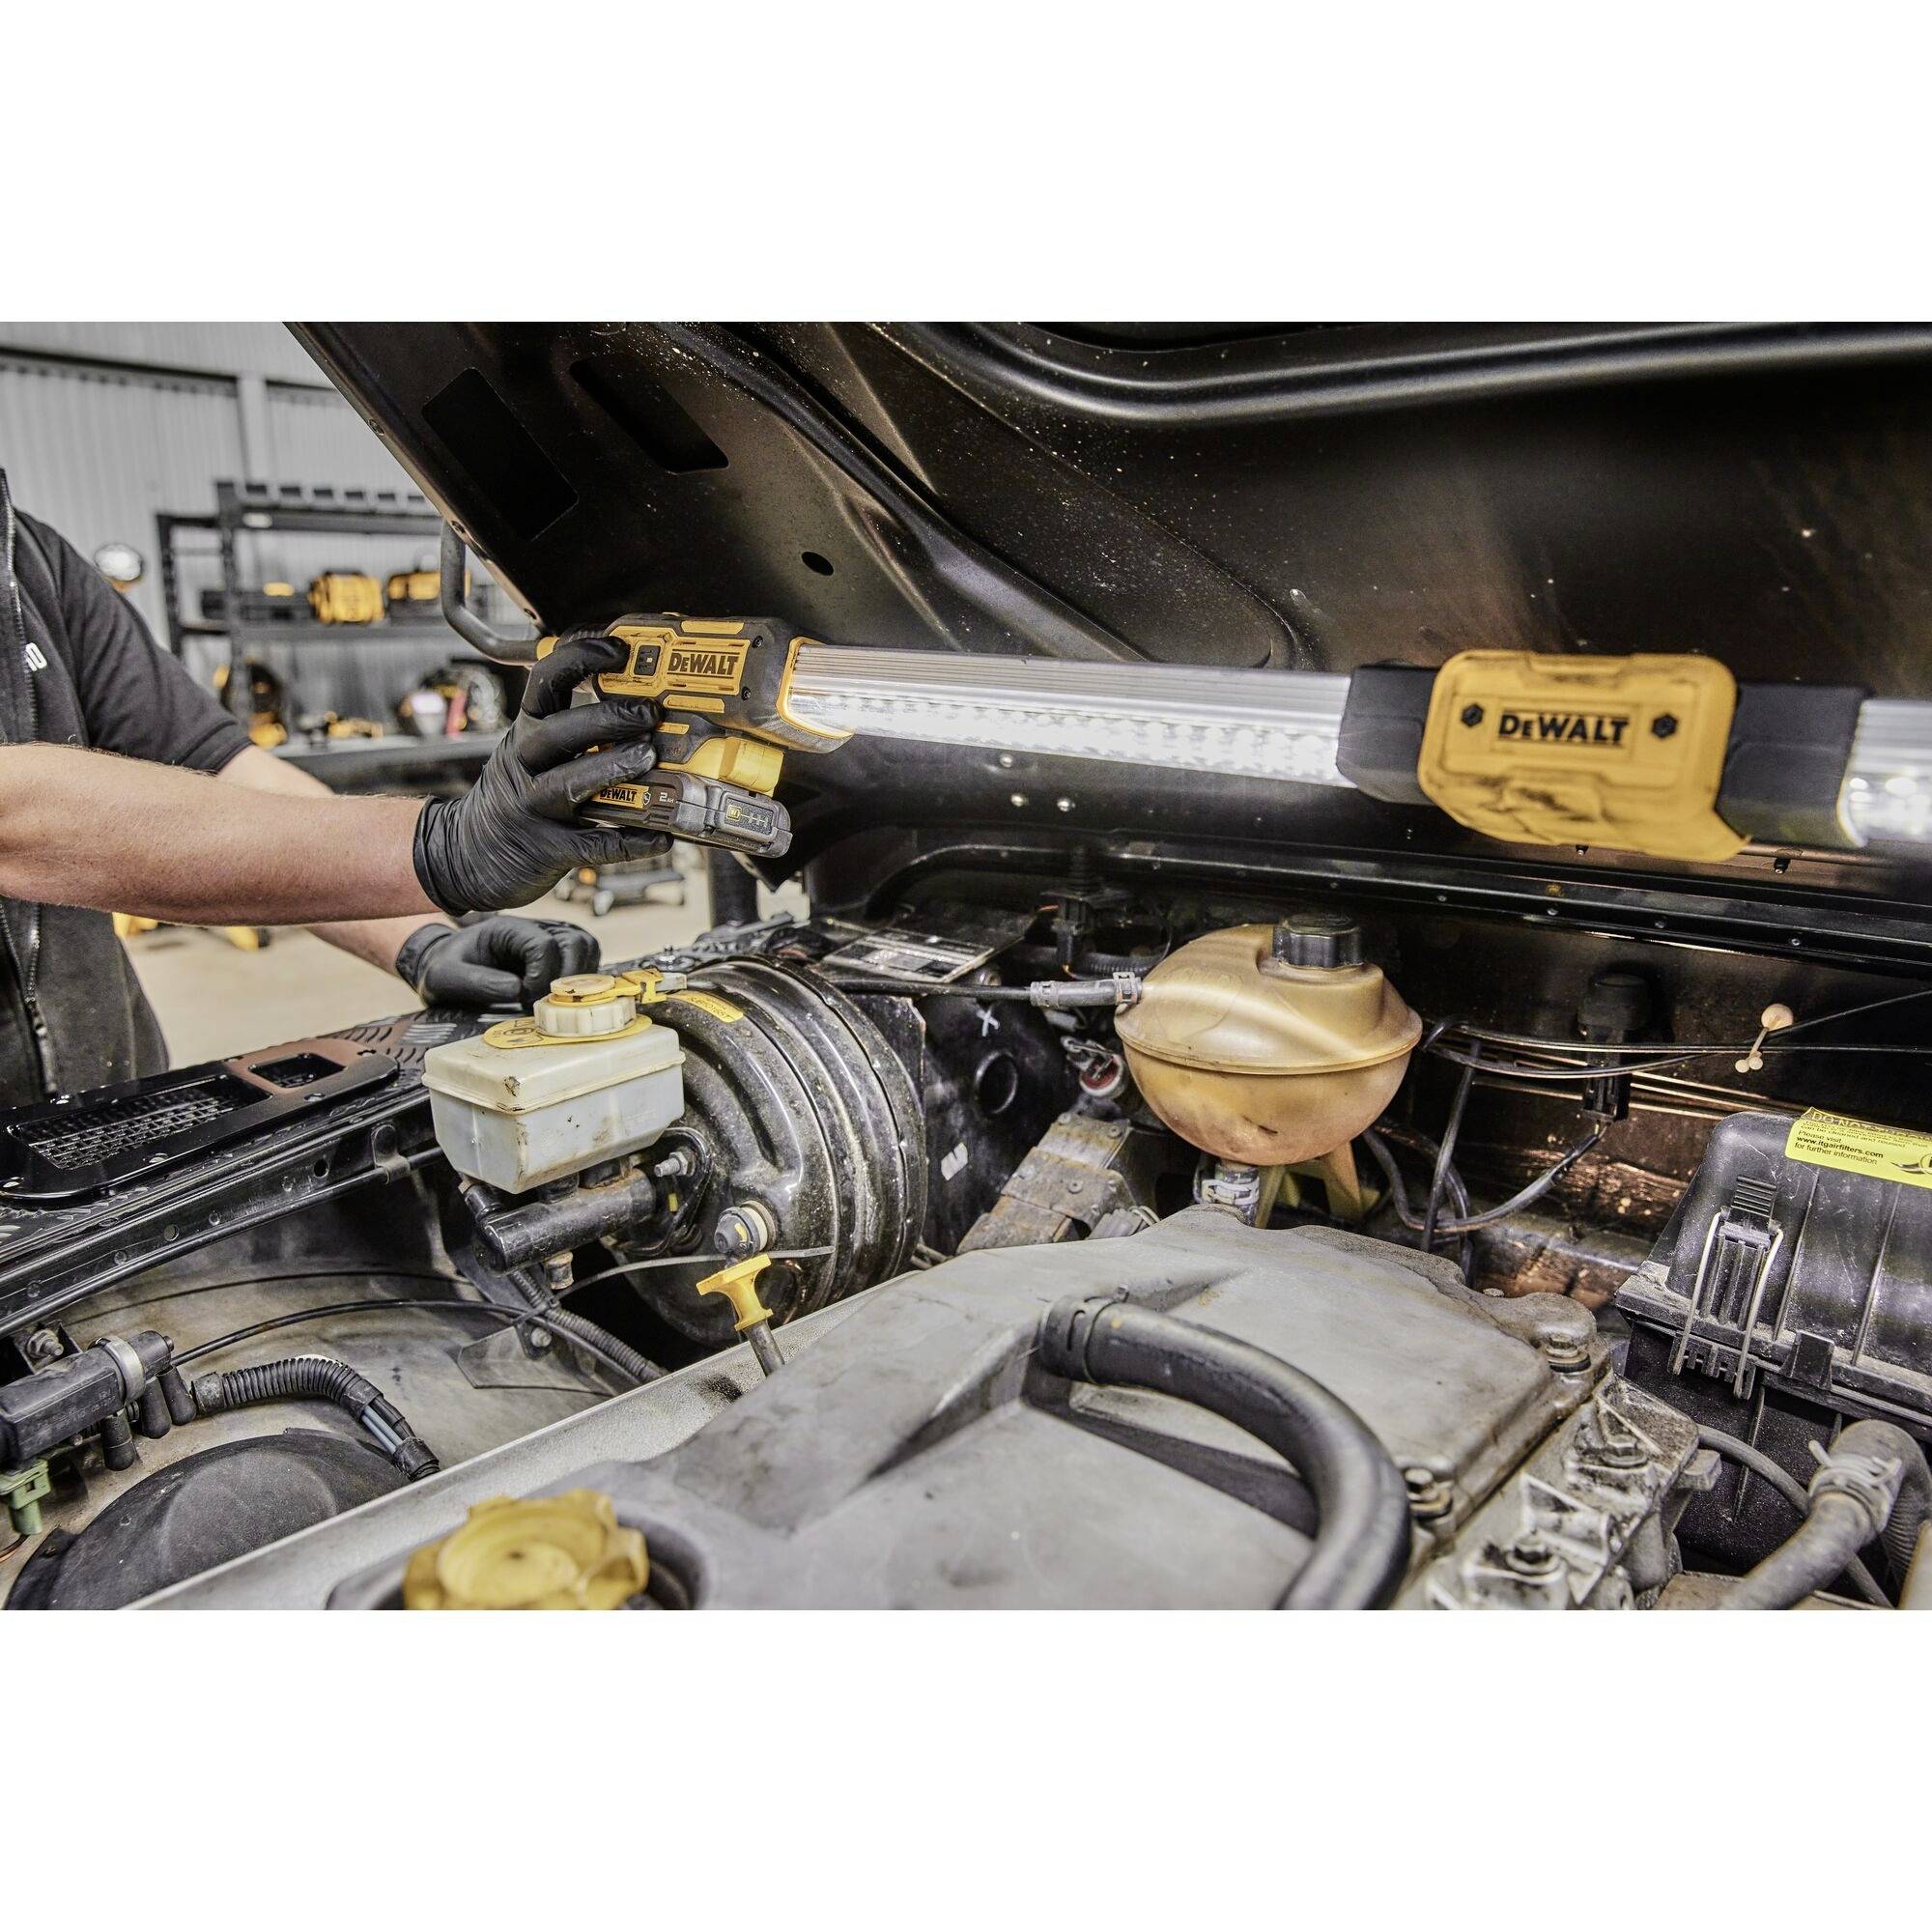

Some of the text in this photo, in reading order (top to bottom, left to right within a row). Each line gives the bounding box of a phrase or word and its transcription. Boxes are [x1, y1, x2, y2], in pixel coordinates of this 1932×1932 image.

[1798, 1130, 1825, 1140] Please
[1797, 1137, 1884, 1158] www.itgairfilters.com
[1806, 1145, 1832, 1155] further
[1833, 1151, 1878, 1165] information
